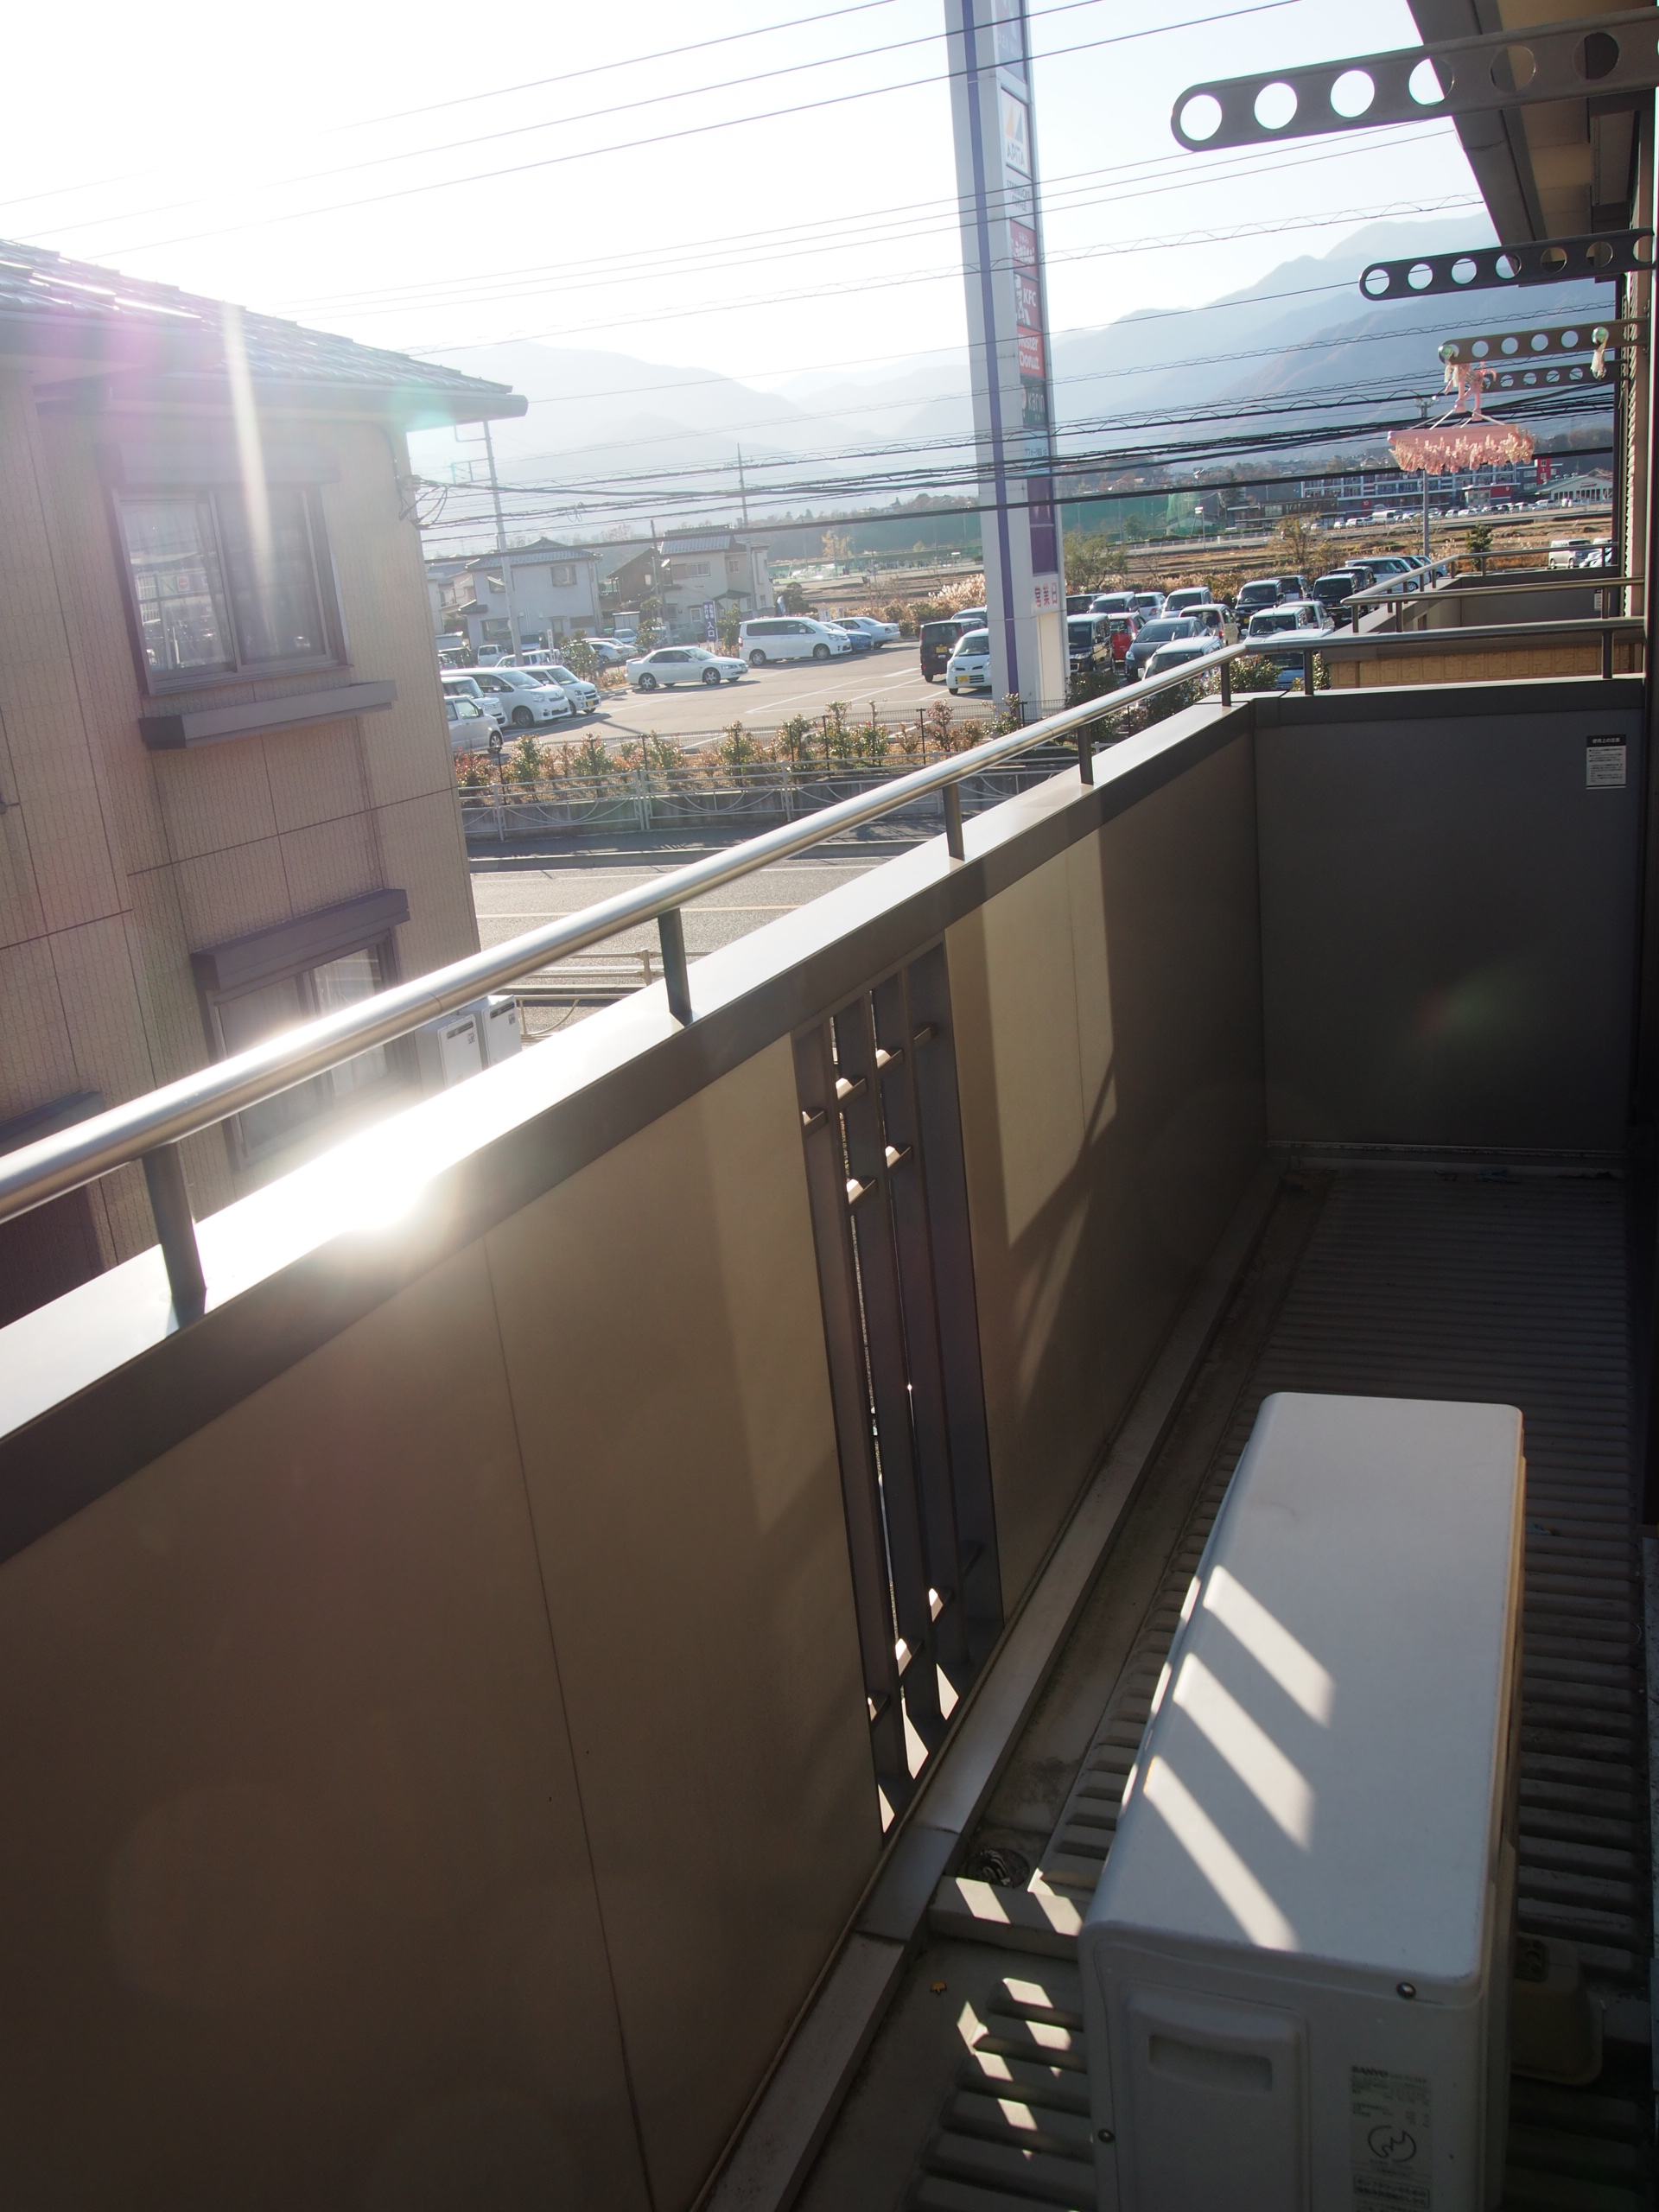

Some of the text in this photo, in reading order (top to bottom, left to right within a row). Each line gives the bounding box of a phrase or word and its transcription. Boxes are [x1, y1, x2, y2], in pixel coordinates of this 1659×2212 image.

[1007, 142, 1026, 168] APITA
[1023, 288, 1037, 308] KFC
[707, 621, 715, 637] 入口
